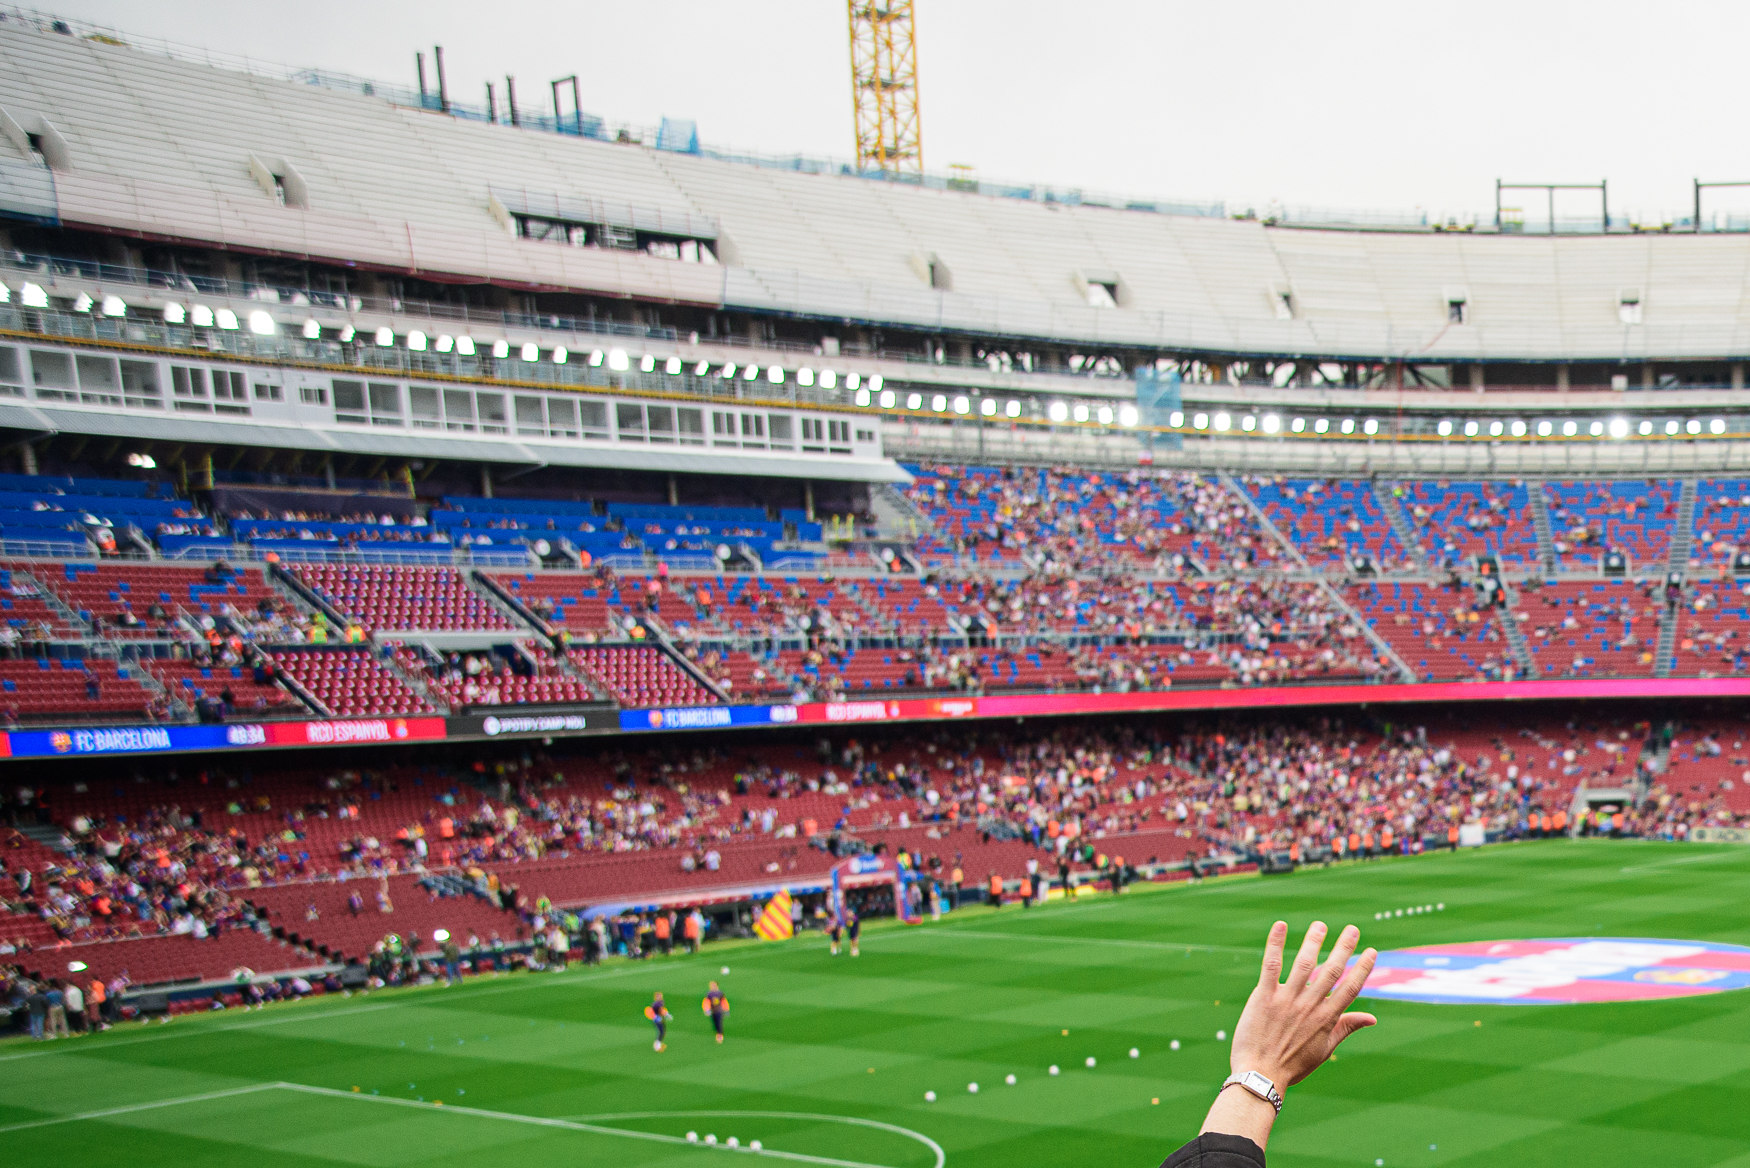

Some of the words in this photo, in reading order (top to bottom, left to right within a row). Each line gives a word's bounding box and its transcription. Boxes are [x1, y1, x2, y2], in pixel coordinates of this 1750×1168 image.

[665, 708, 679, 728] FC
[679, 707, 732, 727] BARCELONA
[76, 729, 95, 751] FC
[94, 727, 172, 751] BARCELONA
[307, 721, 333, 742] RCD
[333, 720, 391, 741] ESPANYOL
